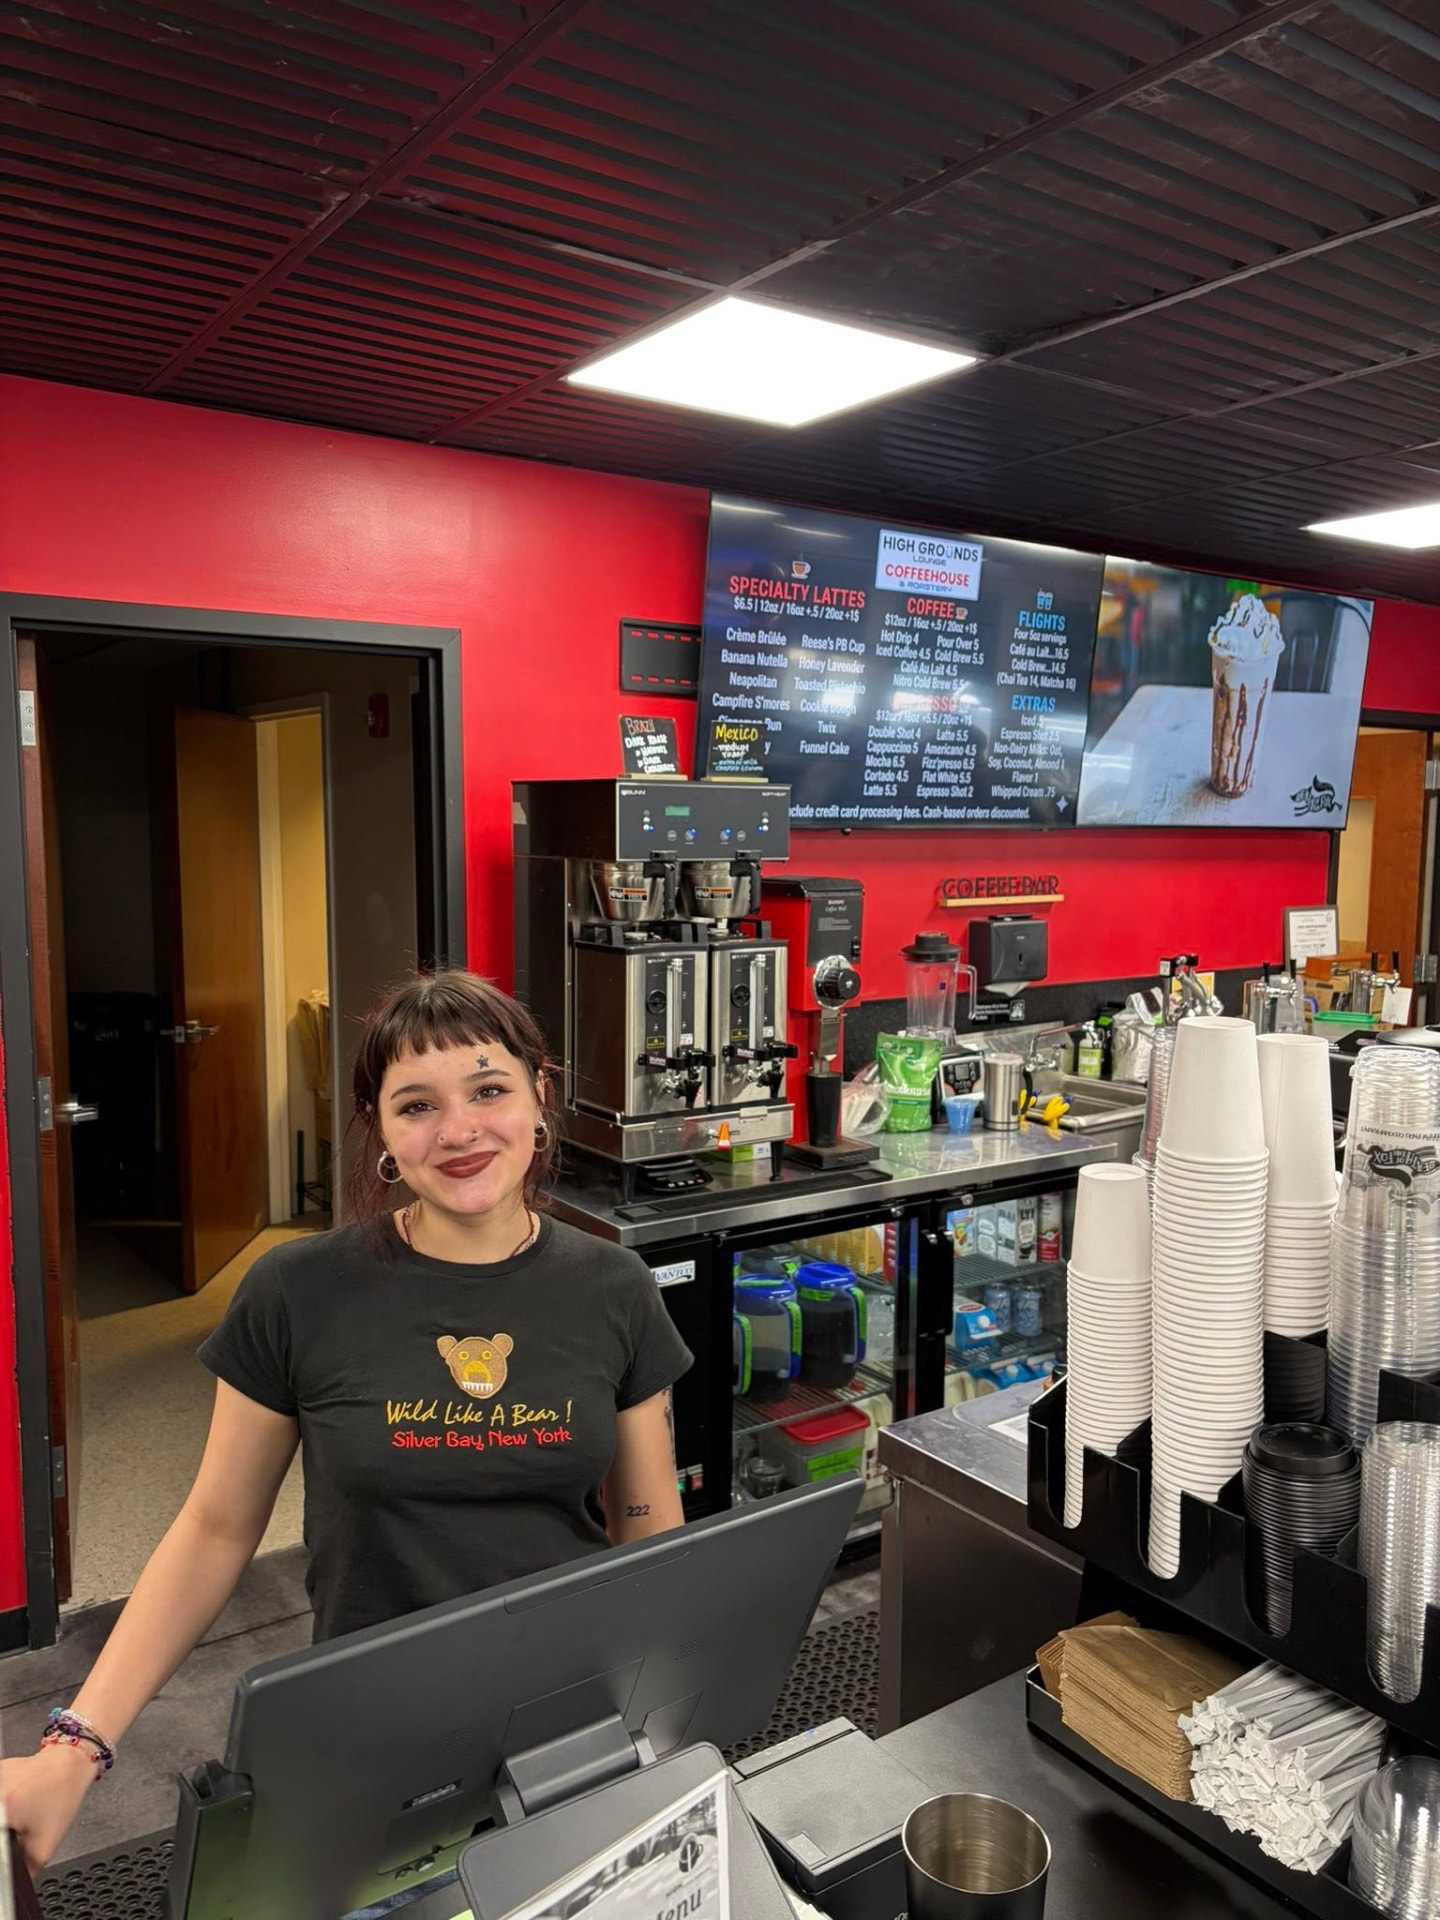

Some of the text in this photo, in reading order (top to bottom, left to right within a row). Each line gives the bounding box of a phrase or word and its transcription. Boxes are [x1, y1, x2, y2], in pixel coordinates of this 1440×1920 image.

[883, 536, 915, 553] HIGH
[912, 555, 946, 566] LOUNGE
[885, 564, 970, 586] COFFEEHOUSE
[729, 575, 865, 608] SPECIALTY LATTES
[907, 581, 952, 592] ROASTERY
[734, 597, 752, 610] $6.5
[760, 601, 778, 612] 12oz
[786, 603, 804, 616] 16oz
[825, 608, 843, 620] 20oz
[845, 609, 860, 623] +1$
[907, 597, 955, 618] COFFEE
[885, 613, 906, 626] $12oz
[914, 617, 929, 629] 16oz
[947, 621, 963, 633] 20oz
[1019, 610, 1065, 631] FLIGHTS
[726, 627, 786, 646] Crème Brûlée
[881, 629, 919, 645] Hot Drip 4
[937, 635, 979, 651] Pour Over 5
[1014, 628, 1028, 639] Four
[1042, 632, 1066, 645] servings
[802, 635, 865, 654] Reese's PB Cup
[876, 643, 930, 660] Iced Coffee 4.5
[1010, 643, 1026, 656] Café
[721, 649, 788, 667] Banana Nutella
[935, 649, 984, 665] Cold Brew 5.5
[799, 656, 865, 674] Honey Lavender
[901, 660, 958, 676] Café Au Lait 4.5
[1012, 659, 1027, 671] Cold
[729, 672, 777, 689] Neapolitan
[794, 677, 826, 691] Toasted
[893, 674, 911, 686] Nitro
[914, 676, 930, 688] Cold
[932, 678, 951, 690] Brew
[1017, 674, 1028, 686] Tea
[1041, 676, 1064, 689] Matcha
[713, 693, 790, 711] Campfire S'mores
[800, 699, 829, 713] Cookie
[1011, 695, 1056, 712] EXTRAS
[818, 721, 836, 734] Twix
[1021, 714, 1036, 726] Iced
[715, 723, 759, 743] Mexico
[868, 725, 921, 739] Double Shot 4
[937, 729, 968, 741] Latte 5.5
[1001, 727, 1031, 742] Espresso
[1033, 729, 1048, 740] Shot
[800, 740, 849, 754] Funnel Cake
[867, 741, 918, 756] Cappuccino 5
[924, 742, 976, 756] Americano 4.5
[994, 742, 1028, 757] Non-Dairy
[865, 755, 905, 768] Mocha 6.5
[963, 758, 975, 770] 6.5
[1034, 758, 1059, 769] Almond
[864, 769, 909, 782] Cortado 4.5
[922, 771, 971, 784] Flat White 5.5
[1012, 771, 1033, 783] Flavor
[864, 784, 897, 796] Latte 5.5
[917, 785, 973, 799] Espresso Shot 2
[992, 785, 1021, 800] Whipped
[1023, 786, 1044, 797] Cream
[816, 805, 839, 818] credit
[841, 805, 859, 818] card
[859, 806, 902, 820] processing
[904, 806, 921, 818] fees.
[923, 806, 965, 818] Cash-based
[966, 807, 990, 818] orders
[991, 807, 1030, 819] discounted.
[942, 875, 1059, 899] COFFEE BAR
[386, 1400, 438, 1424] Wild
[444, 1401, 482, 1424] Like
[490, 1402, 505, 1426] A
[512, 1404, 559, 1426] Bear
[392, 1430, 440, 1450] Silver
[489, 1431, 527, 1448] New
[532, 1426, 572, 1445] York
[627, 1504, 650, 1516] 222
